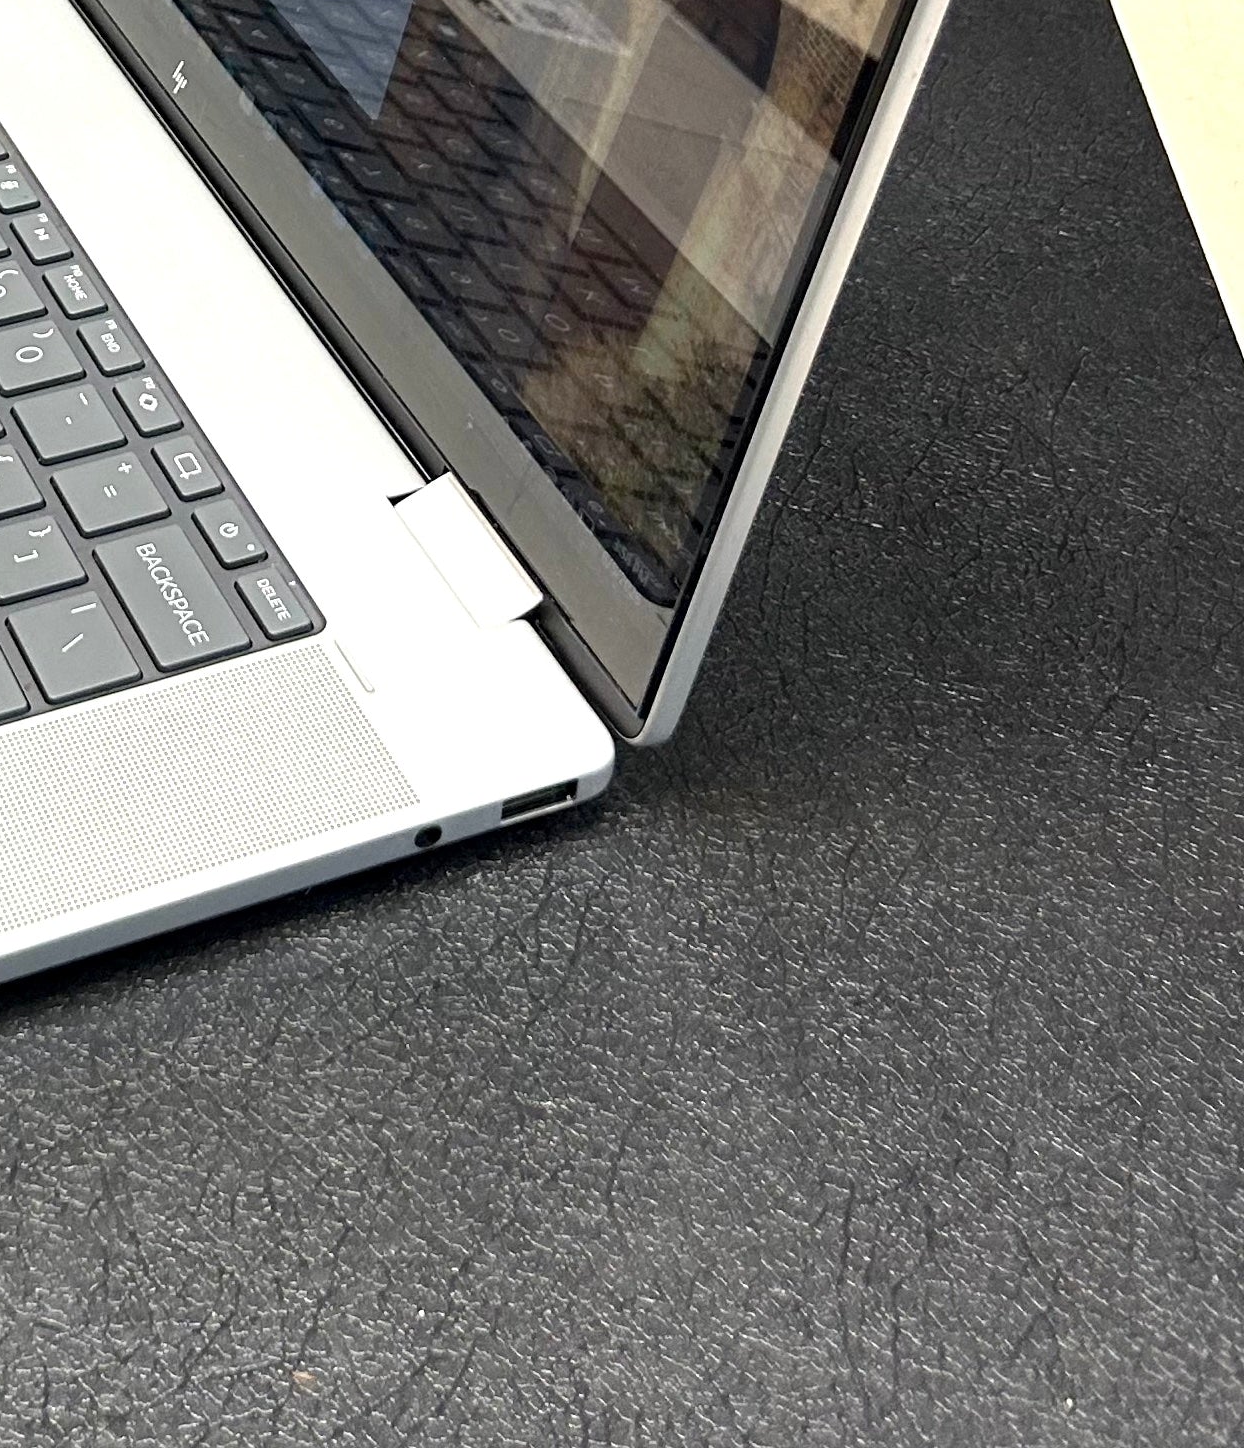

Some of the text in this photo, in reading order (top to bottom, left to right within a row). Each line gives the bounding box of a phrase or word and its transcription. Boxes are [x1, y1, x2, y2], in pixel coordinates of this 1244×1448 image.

[63, 274, 88, 301] HOME
[32, 327, 54, 339] )
[100, 332, 121, 353] END
[15, 346, 44, 363] 0
[117, 462, 133, 474] +
[103, 485, 118, 498] =
[135, 542, 210, 647] BACKSPACE
[256, 578, 292, 622] DELETE
